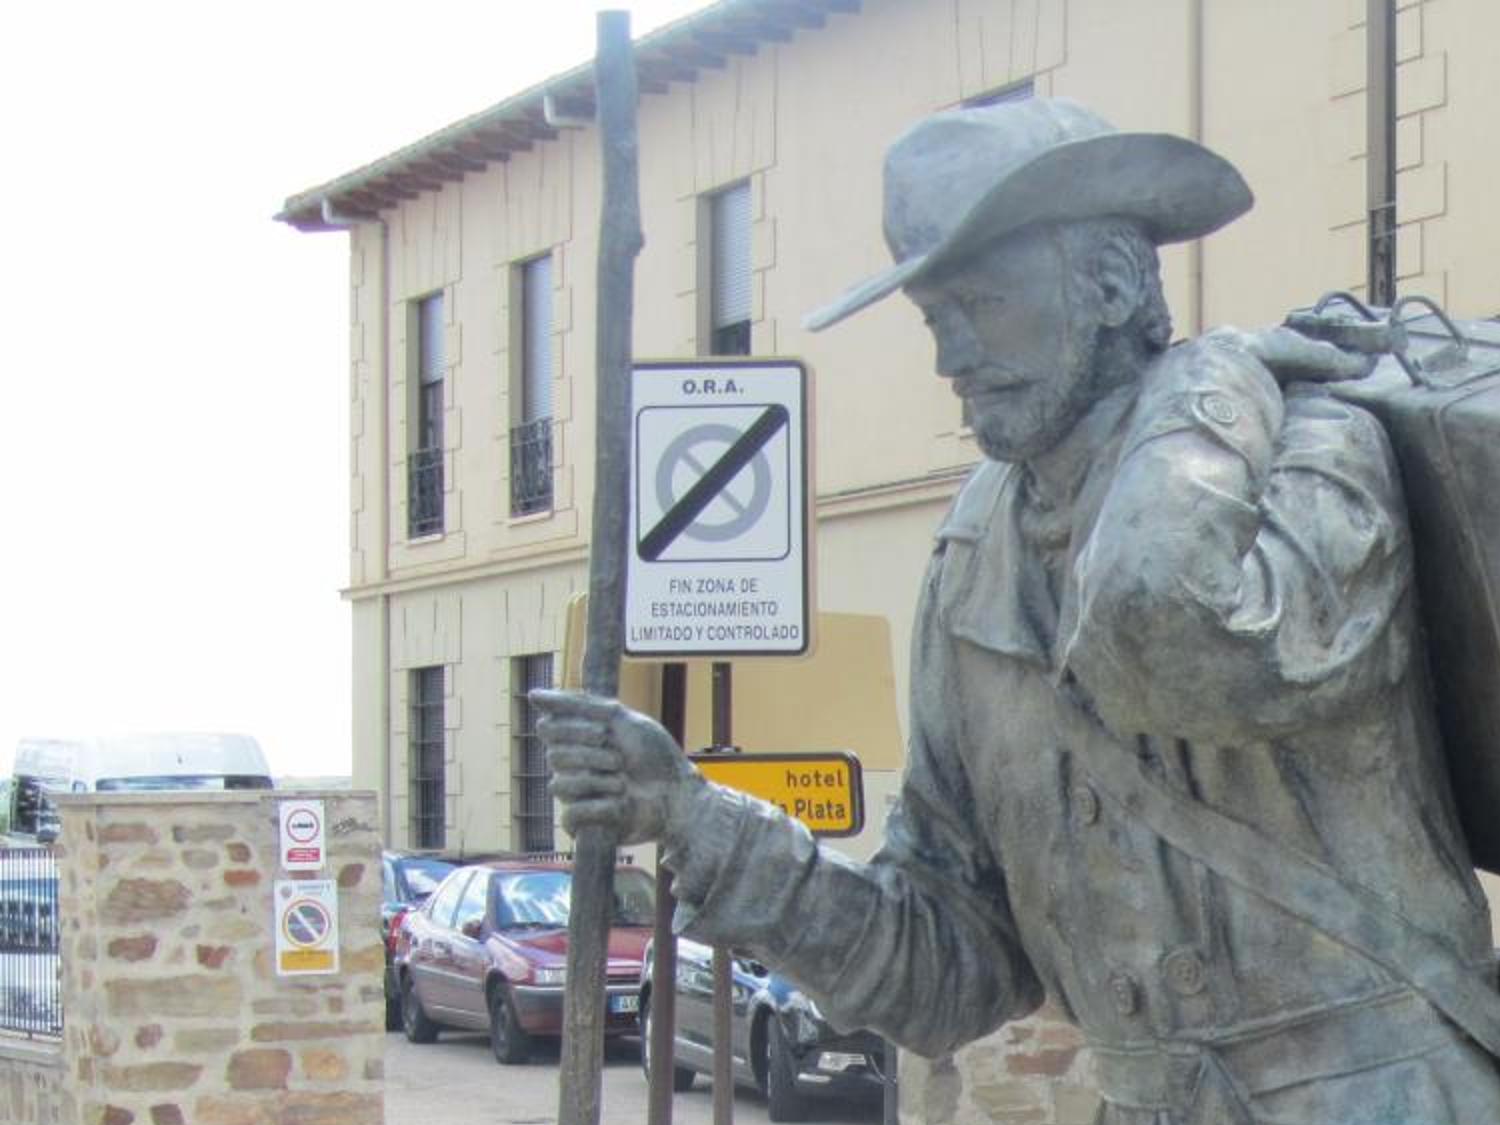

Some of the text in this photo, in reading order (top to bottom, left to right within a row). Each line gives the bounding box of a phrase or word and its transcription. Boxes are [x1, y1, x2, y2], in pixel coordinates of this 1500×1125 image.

[682, 379, 744, 395] O.R.A.
[669, 577, 758, 594] FIN ZONA DE
[650, 601, 778, 618] ESTACIONAMIENTO
[631, 624, 800, 642] LIMITADO Y CONTROLADO
[786, 769, 843, 788] hotel
[795, 799, 846, 820] Plata
